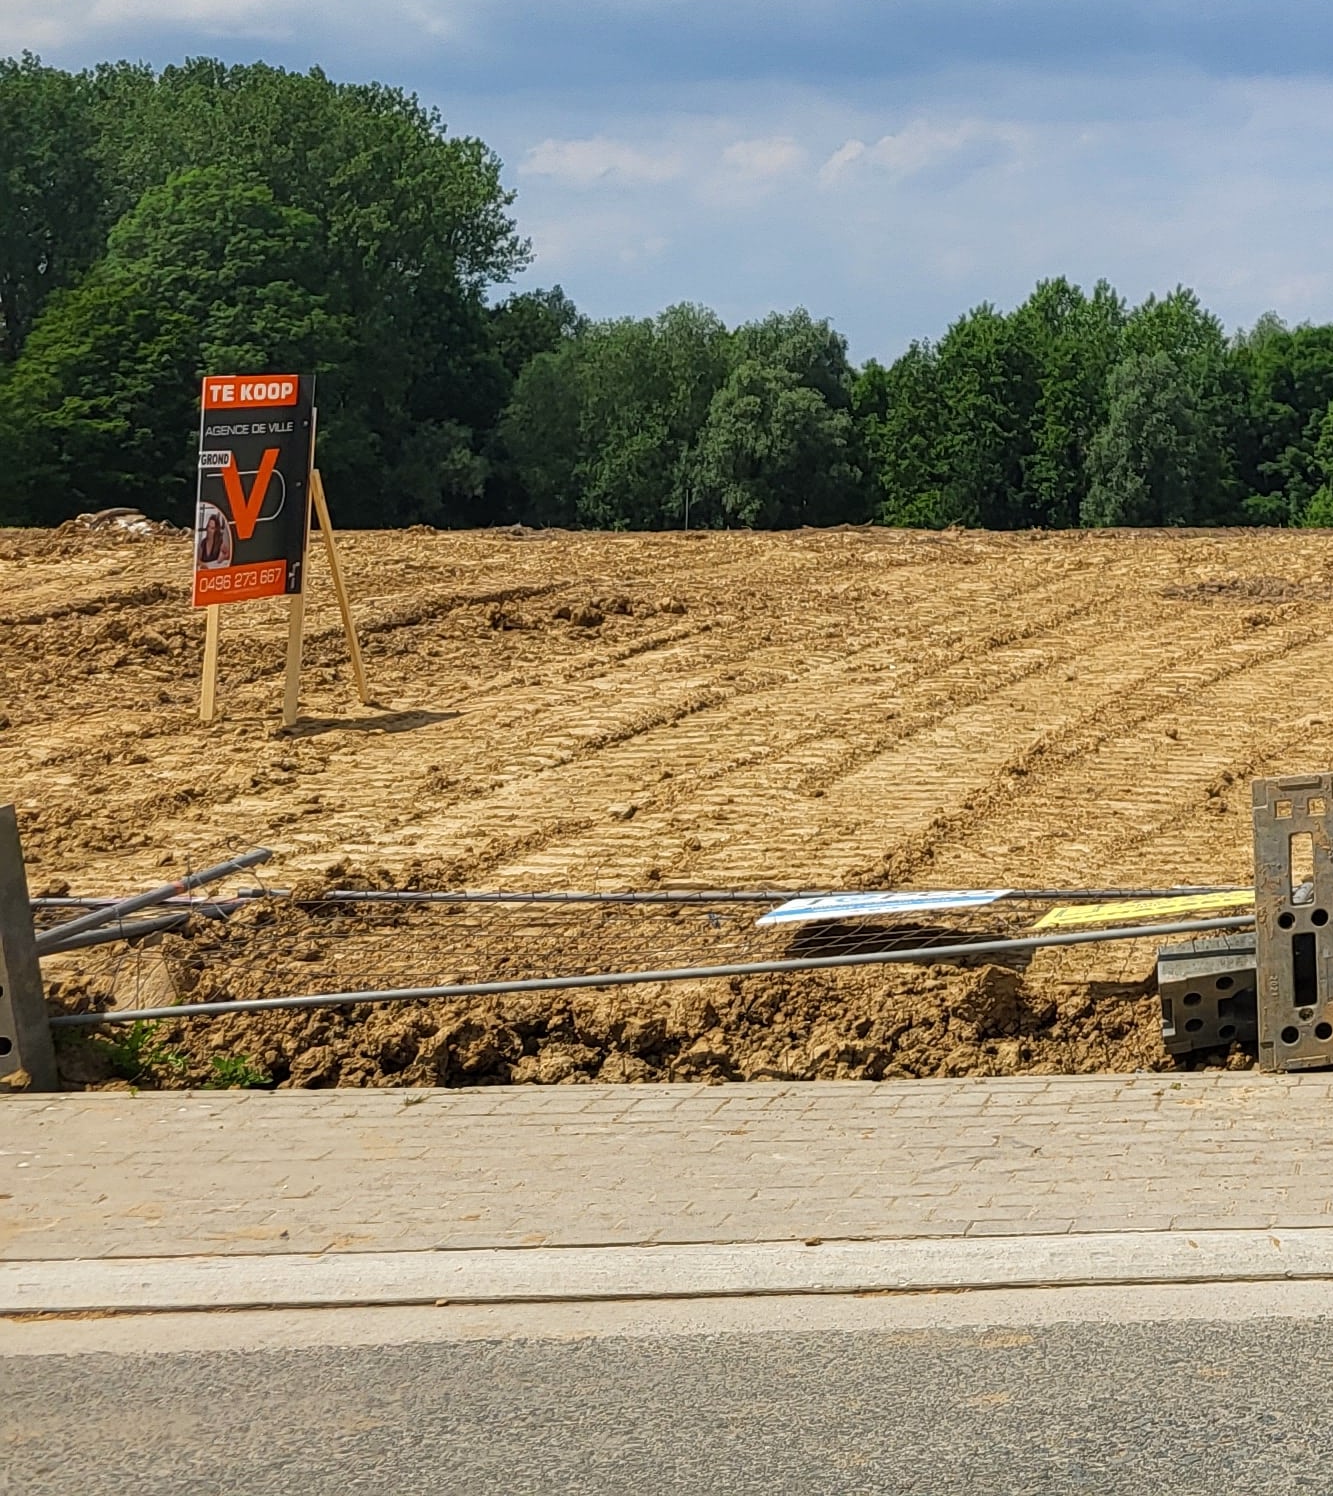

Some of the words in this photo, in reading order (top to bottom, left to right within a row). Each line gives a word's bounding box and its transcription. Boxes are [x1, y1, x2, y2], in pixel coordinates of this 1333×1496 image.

[210, 384, 235, 402] TE
[240, 382, 293, 401] KOOP
[205, 423, 249, 437] AGENCE
[252, 423, 266, 434] DE
[268, 421, 294, 433] VILLE
[199, 575, 231, 593] 0496
[234, 571, 257, 588] 273
[260, 568, 282, 584] 667
